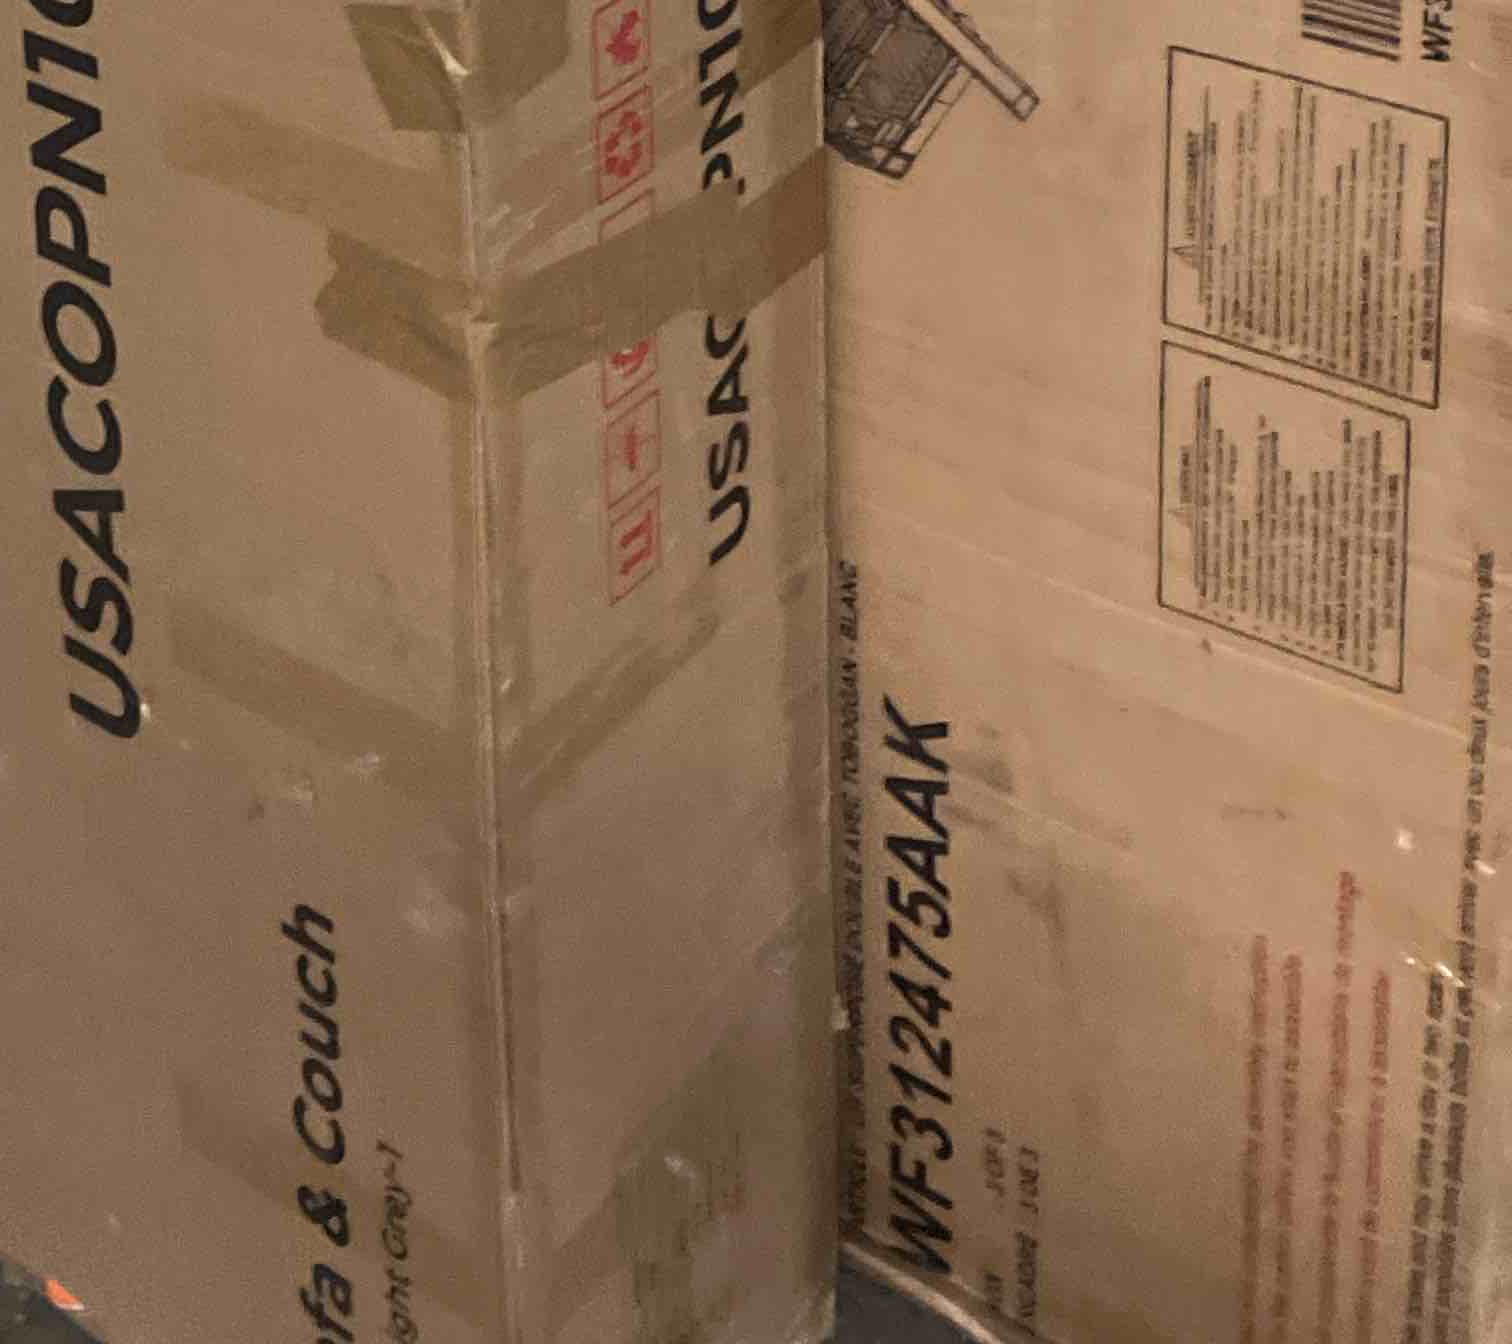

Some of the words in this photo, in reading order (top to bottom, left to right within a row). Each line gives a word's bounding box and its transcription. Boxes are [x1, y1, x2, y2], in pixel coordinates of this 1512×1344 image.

[839, 561, 857, 640] BLANC
[883, 692, 952, 1275] WF312475AAK
[281, 904, 345, 1165] Couch
[296, 1185, 349, 1247] &
[300, 1264, 356, 1344] fa
